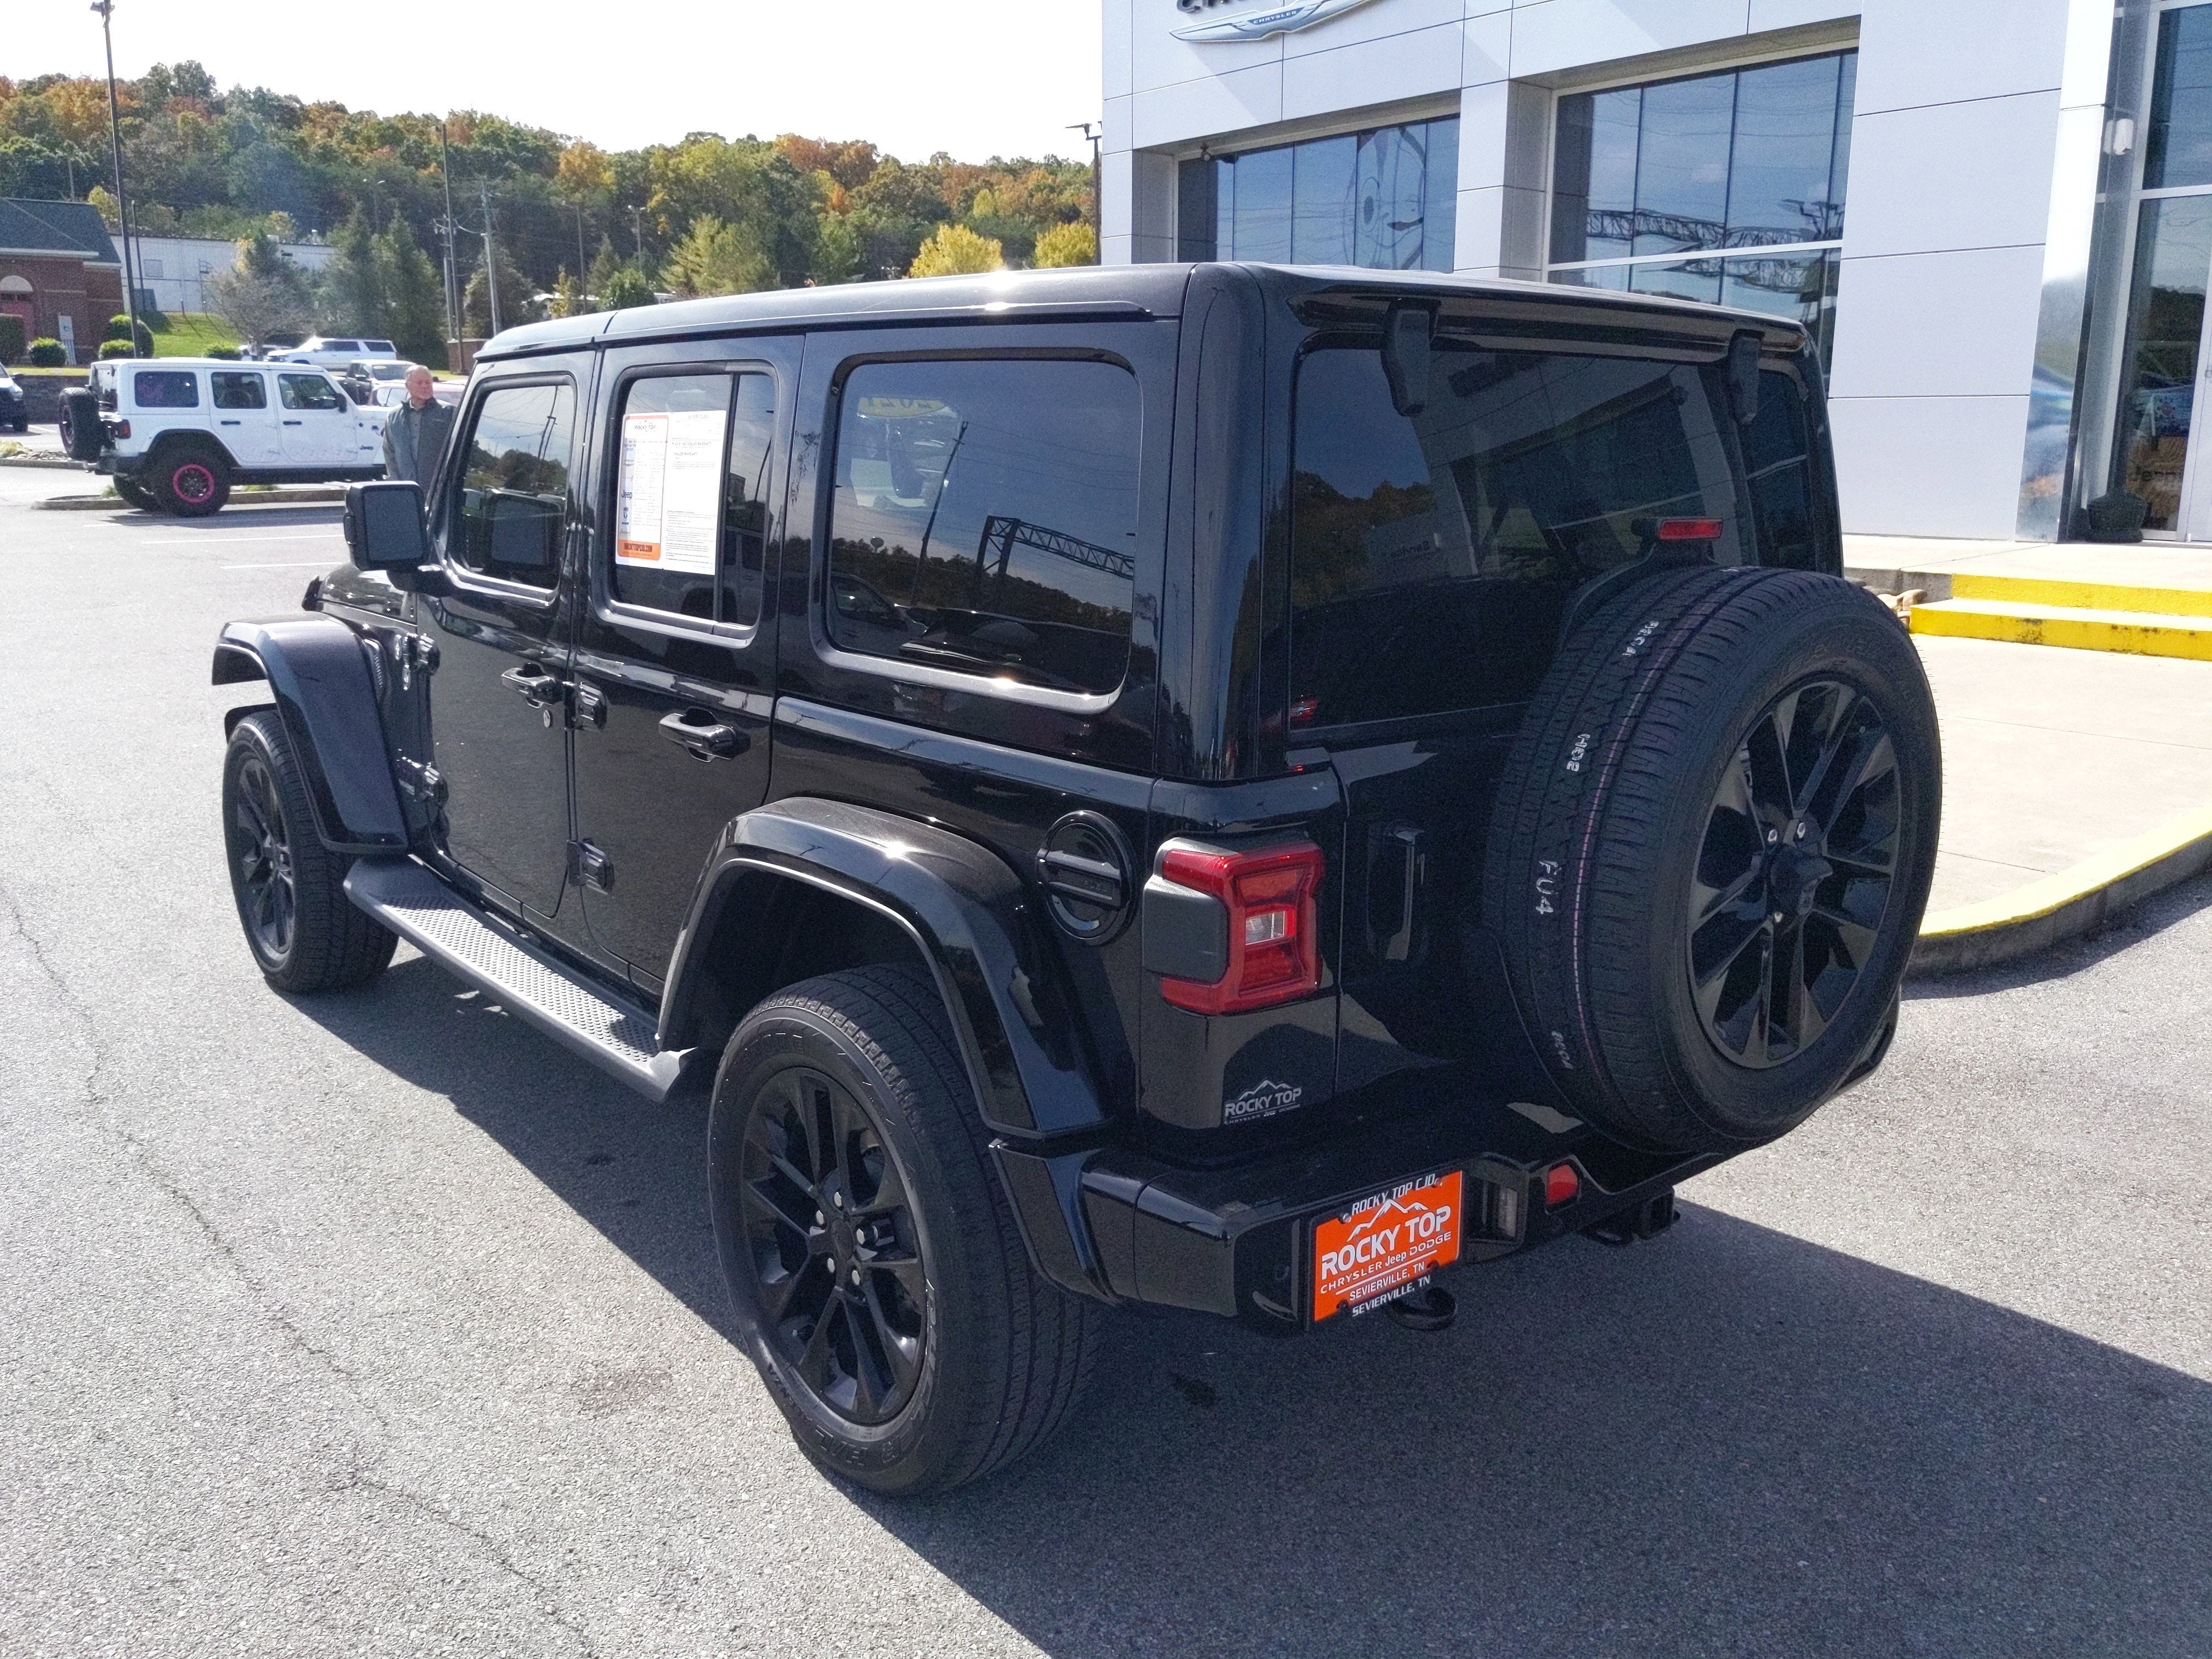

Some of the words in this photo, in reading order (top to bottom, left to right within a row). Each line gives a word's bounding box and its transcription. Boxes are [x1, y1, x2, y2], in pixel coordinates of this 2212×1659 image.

[1253, 10, 1296, 24] CHRYSLER
[1225, 1094, 1273, 1117] ROCKY
[1275, 1087, 1302, 1105] TOP
[1352, 1189, 1389, 1215] ROCKY
[1392, 1181, 1413, 1200] TOP
[1415, 1173, 1441, 1191] CJD
[1321, 1224, 1401, 1280] ROCKY
[1404, 1205, 1451, 1243] TOP
[1321, 1261, 1382, 1294] CHRYSLER
[1385, 1251, 1407, 1267] Jeep
[1409, 1231, 1452, 1256] DODGE
[1349, 1268, 1410, 1301] SEVIERVILLE,
[1413, 1261, 1425, 1273] TN
[1352, 1282, 1415, 1317] SEVIERVILLE,
[1418, 1274, 1431, 1288] TN
